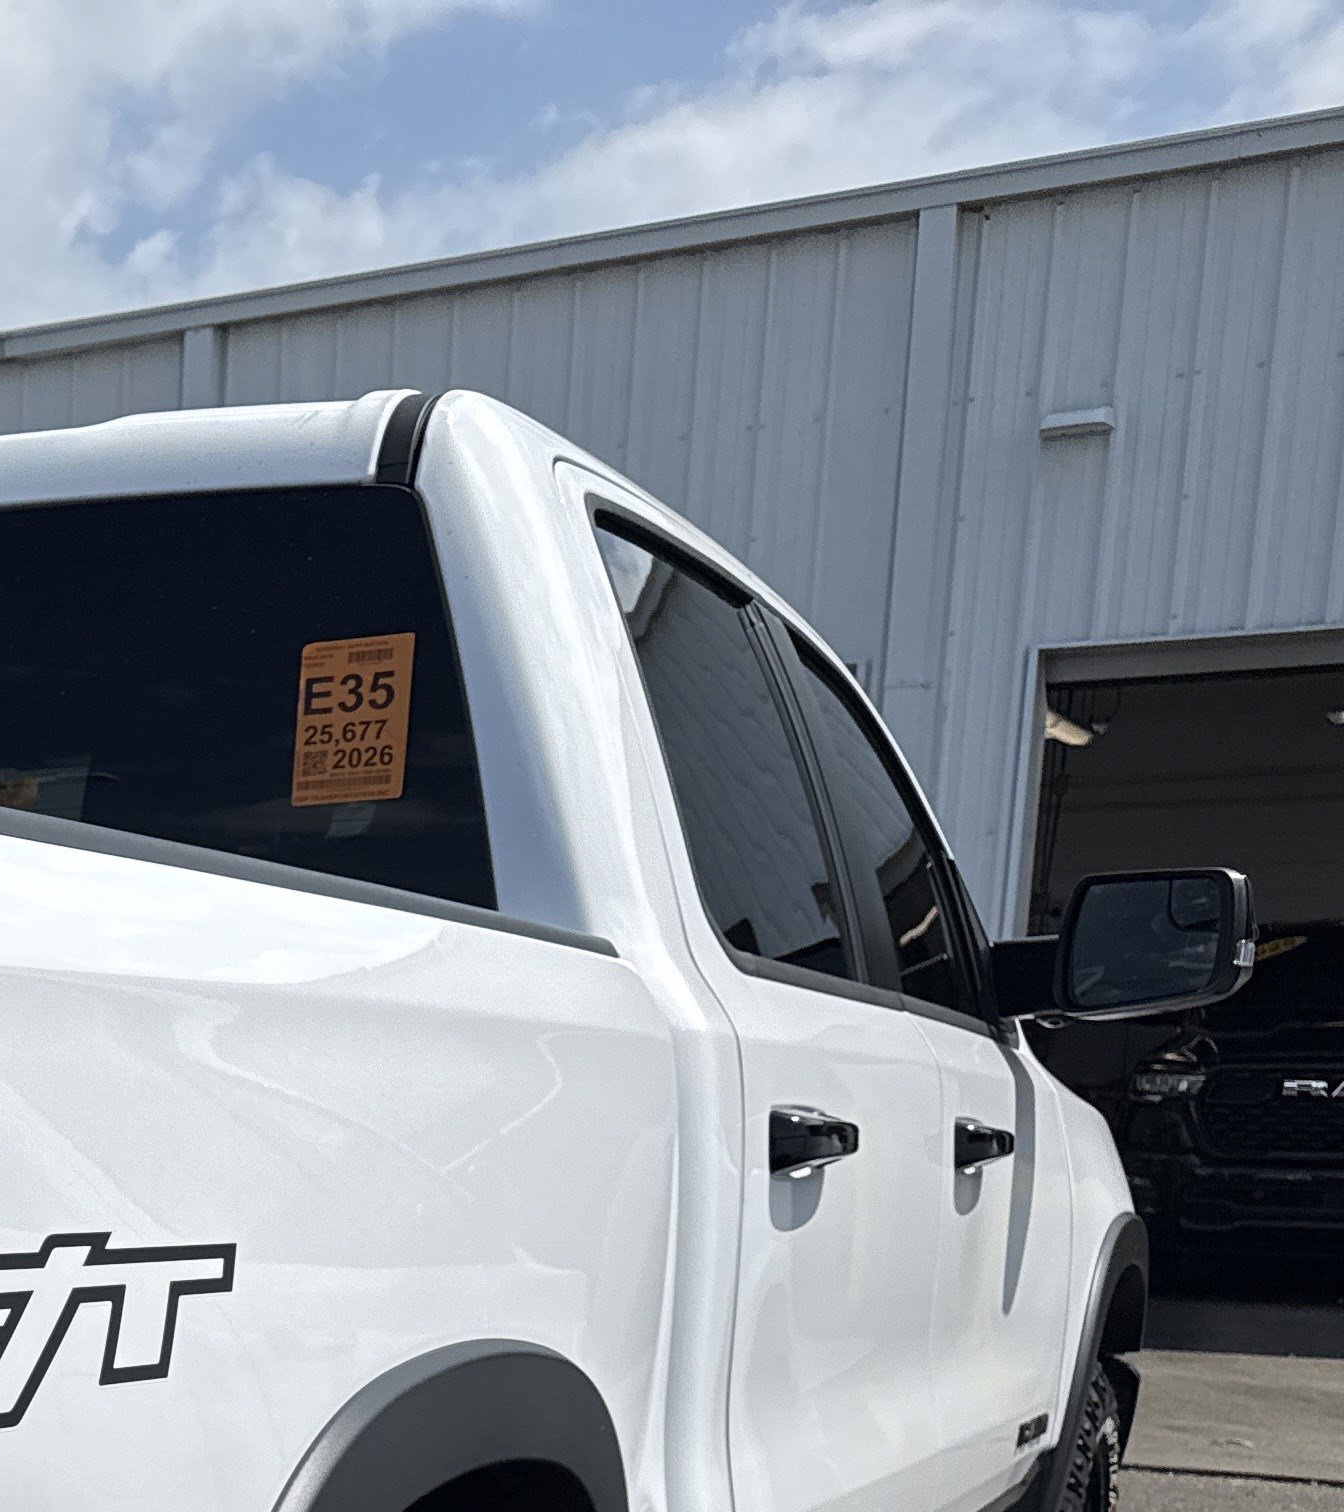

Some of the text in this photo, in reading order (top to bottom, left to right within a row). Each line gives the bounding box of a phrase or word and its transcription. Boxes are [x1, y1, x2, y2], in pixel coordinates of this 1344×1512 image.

[304, 670, 395, 716] E35
[303, 719, 388, 747] 25,677
[332, 744, 393, 770] 2026
